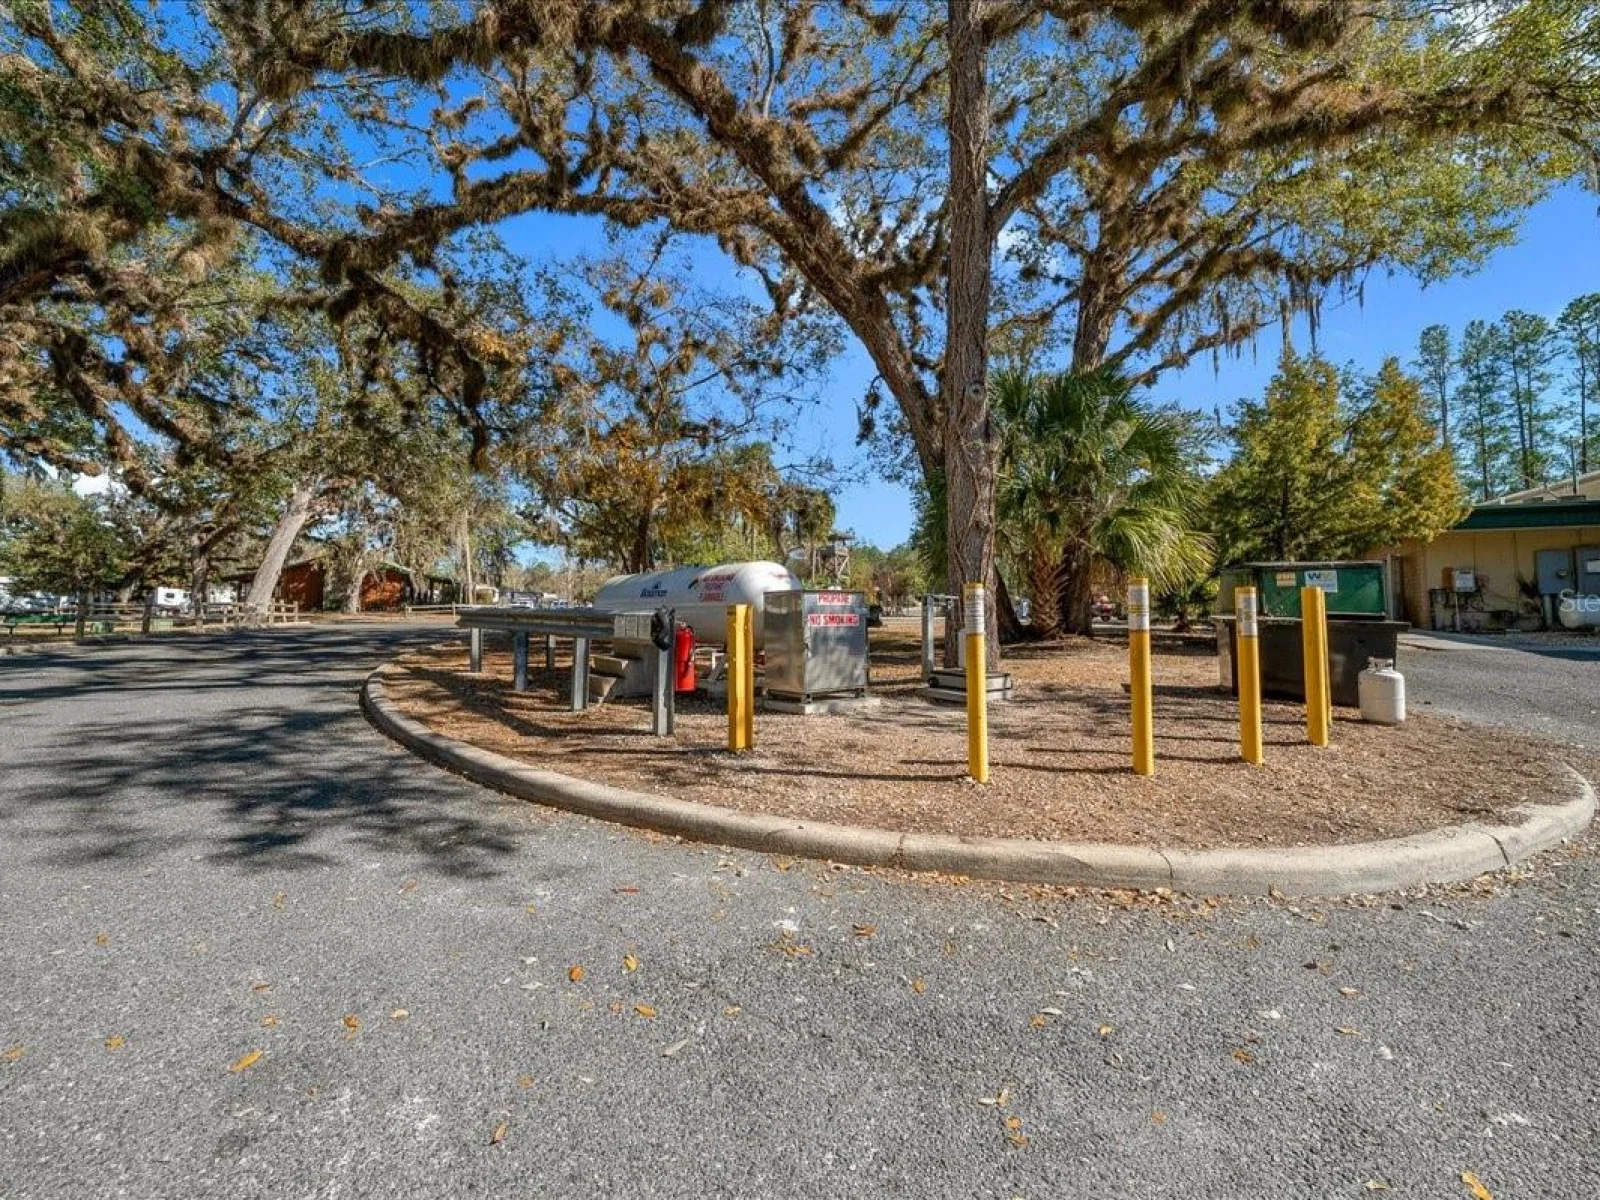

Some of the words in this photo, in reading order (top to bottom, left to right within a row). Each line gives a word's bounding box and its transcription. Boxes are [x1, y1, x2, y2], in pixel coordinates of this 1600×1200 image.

[818, 591, 850, 602] PROPANE
[809, 614, 821, 626] NO
[823, 614, 859, 626] SMOKING
